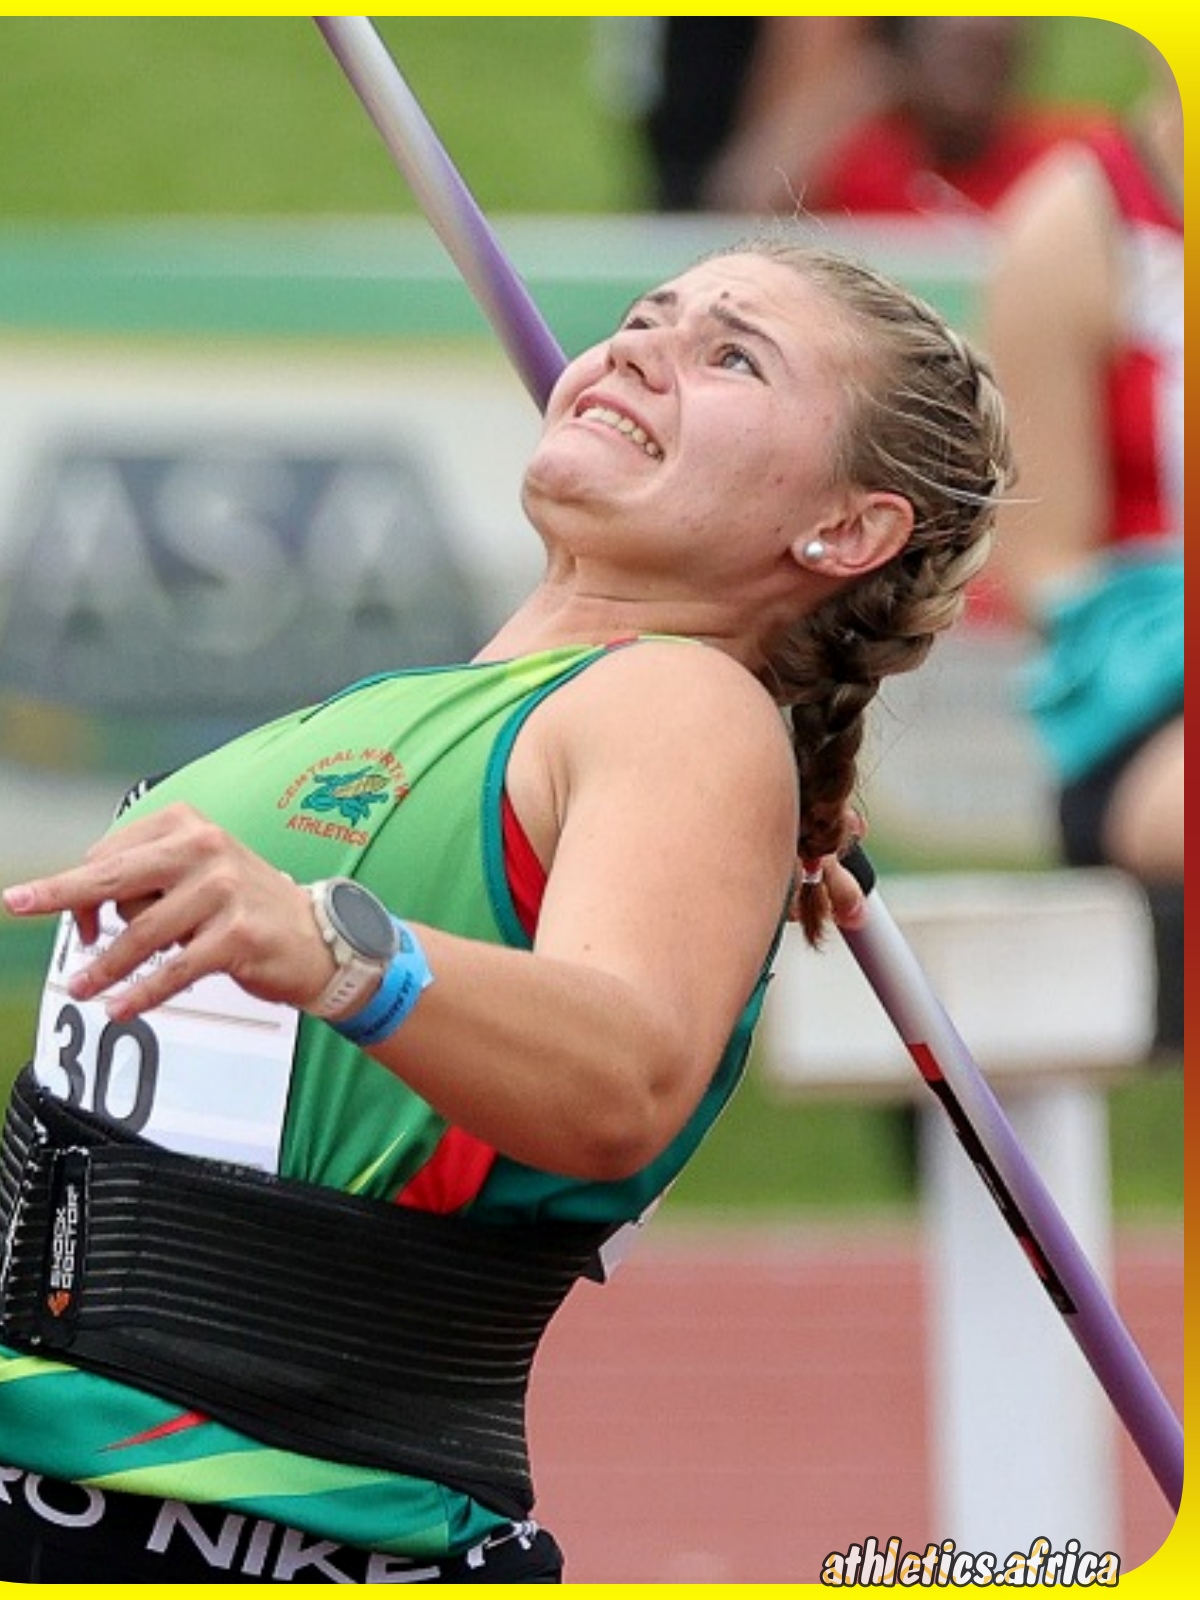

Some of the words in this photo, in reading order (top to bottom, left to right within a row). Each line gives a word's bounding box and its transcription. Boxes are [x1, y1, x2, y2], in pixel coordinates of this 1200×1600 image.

[277, 749, 353, 809] CENTRAL
[286, 813, 370, 846] ATHLETICS
[53, 1003, 160, 1136] 30
[50, 1206, 67, 1289] SHOCK
[61, 1183, 79, 1290] DOCTOR
[145, 1499, 441, 1585] NIKE
